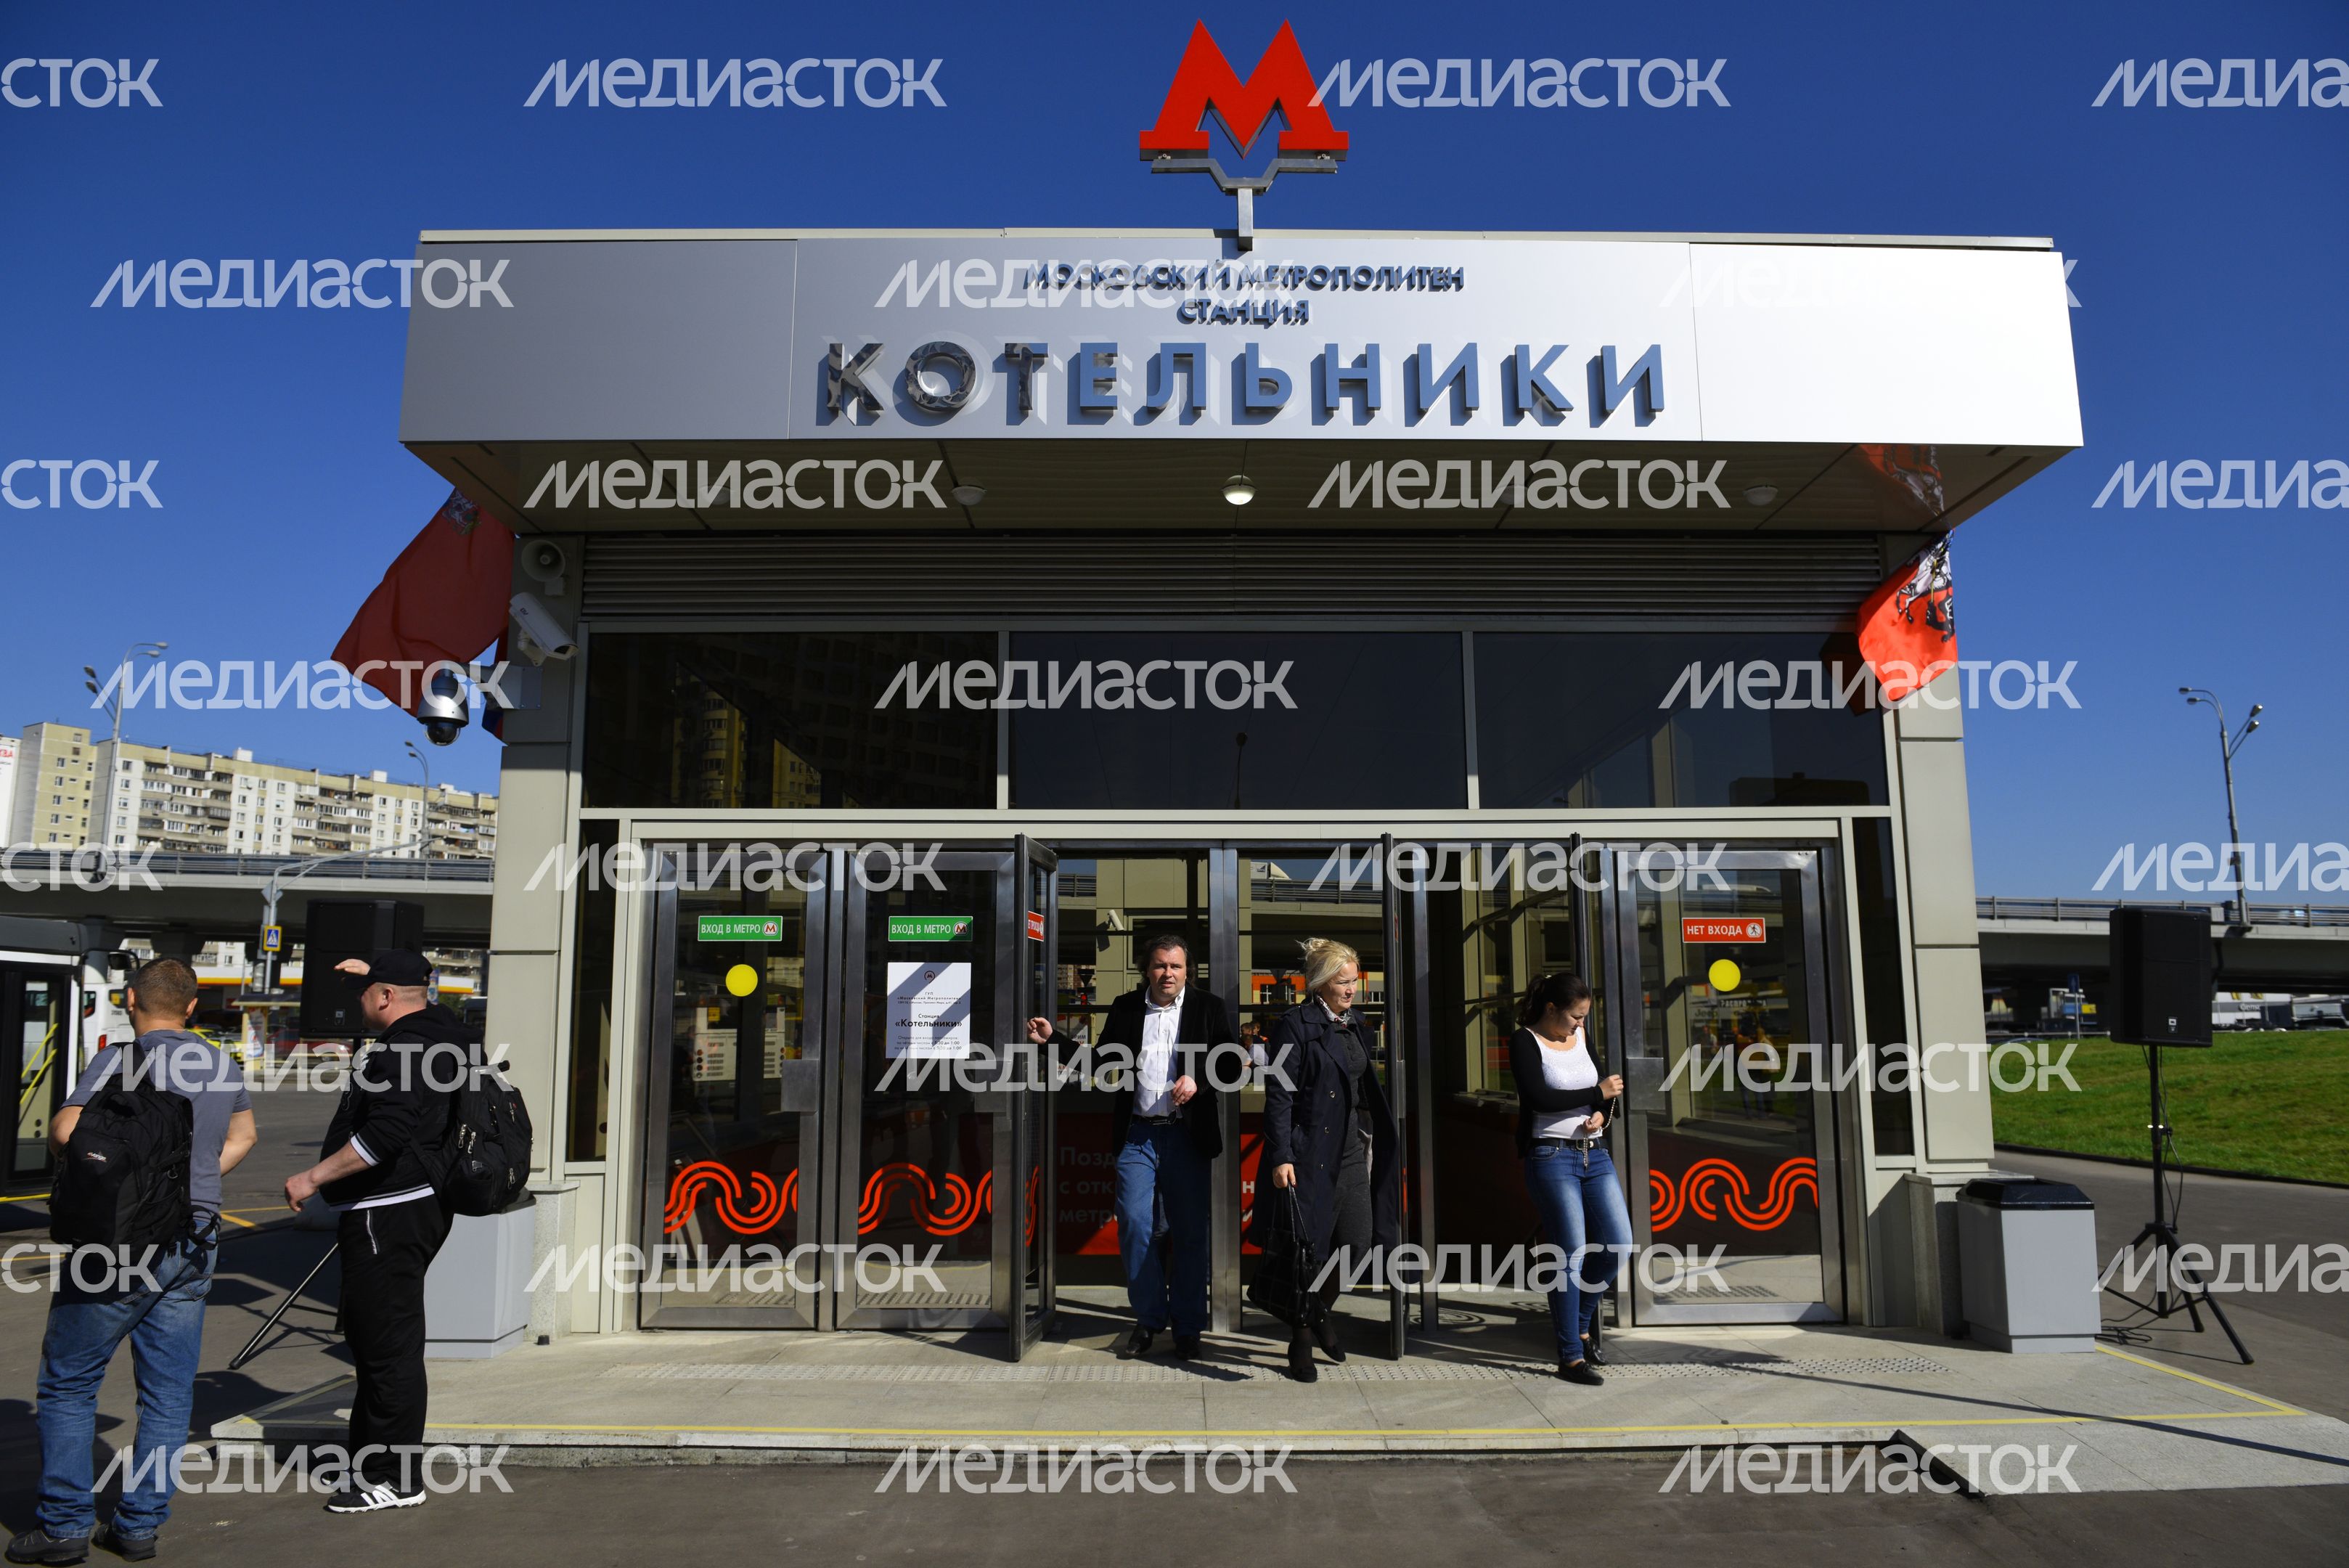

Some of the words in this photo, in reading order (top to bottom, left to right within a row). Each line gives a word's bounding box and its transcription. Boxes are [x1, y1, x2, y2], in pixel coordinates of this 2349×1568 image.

[1026, 259, 1230, 288] МОСКОВСКИЙ
[1240, 264, 1465, 290] МЕТРОПОЛИТЕН
[1178, 298, 1310, 325] СТАНЦИЯ
[825, 341, 1664, 414] КОТЕЛЬНИКИ
[701, 924, 724, 935] ВХОД
[726, 924, 731, 934] В
[734, 924, 761, 934] МЕТРО
[891, 924, 914, 935] ВХОД
[916, 925, 921, 934] В
[924, 925, 951, 934] МЕТРО
[1687, 926, 1704, 934] НЕТ
[1708, 926, 1742, 936] ВХОДА
[895, 1018, 963, 1027] «Котельники»
[1060, 1181, 1069, 1194] с
